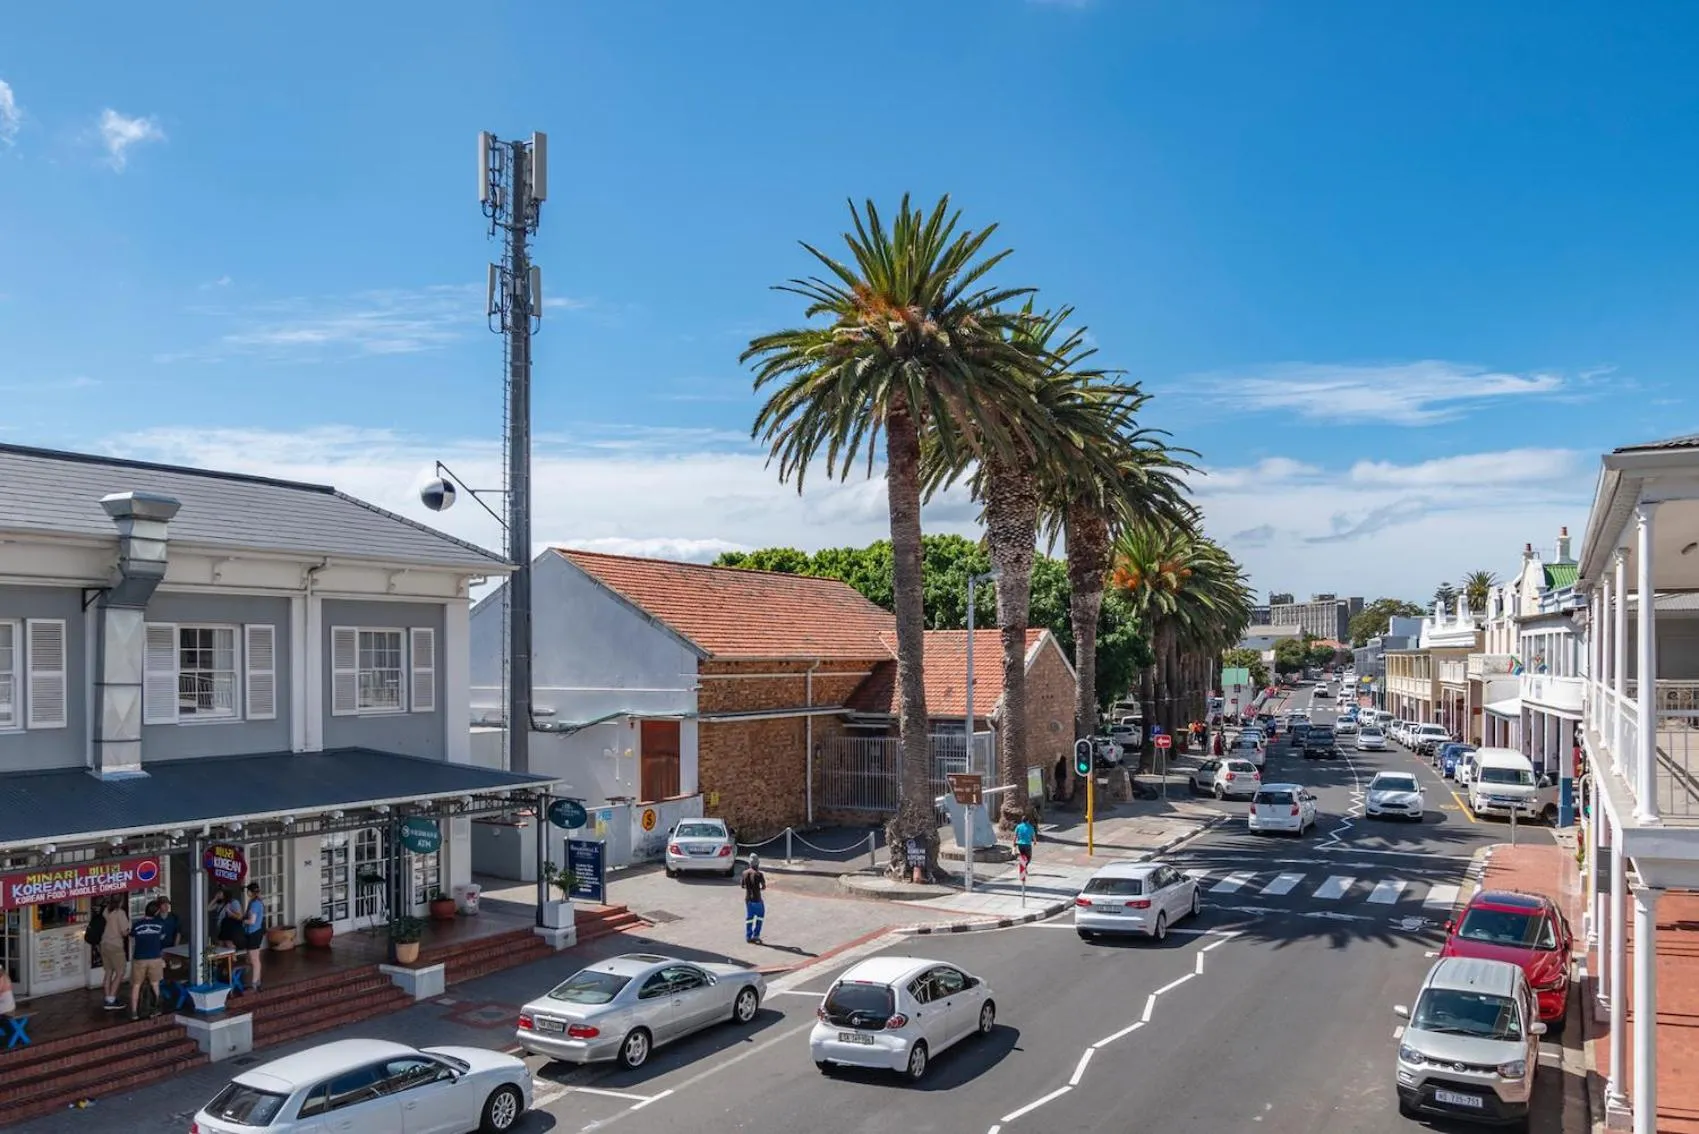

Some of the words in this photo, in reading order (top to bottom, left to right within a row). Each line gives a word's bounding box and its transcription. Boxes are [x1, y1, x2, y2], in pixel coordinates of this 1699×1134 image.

[214, 856, 241, 873] KOREAN
[12, 879, 73, 898] KOREAN
[75, 870, 133, 888] KITCHEN
[26, 869, 78, 884] MINARI
[15, 893, 45, 905] KOREAN
[47, 890, 67, 900] FOOD
[70, 886, 97, 897] NOODLE
